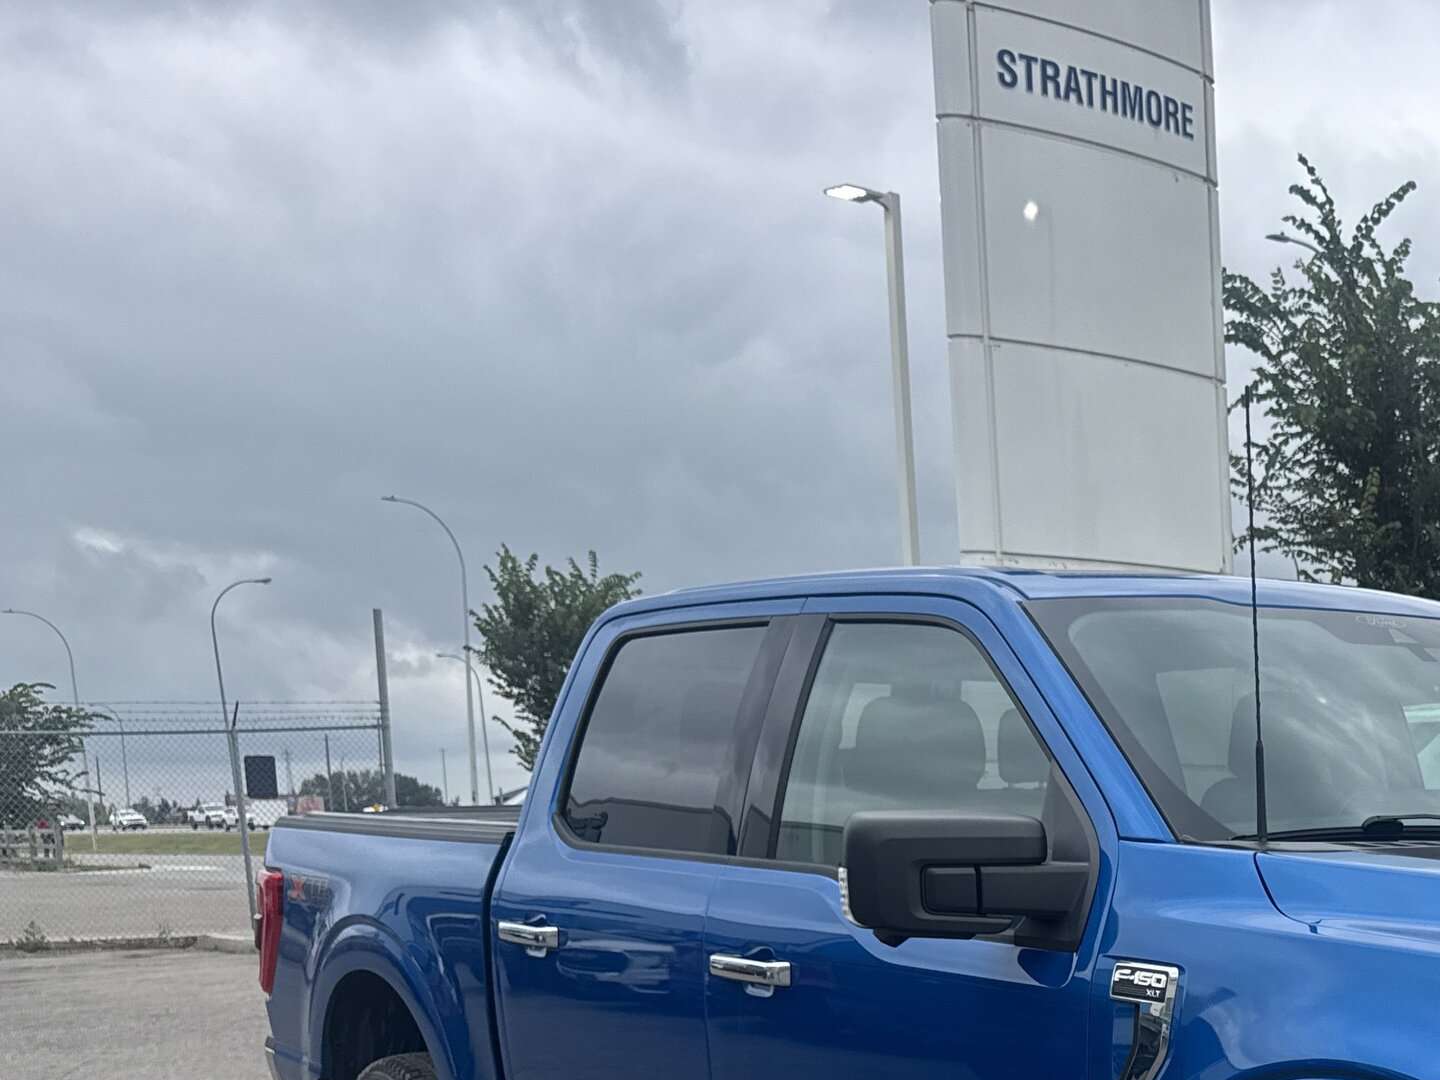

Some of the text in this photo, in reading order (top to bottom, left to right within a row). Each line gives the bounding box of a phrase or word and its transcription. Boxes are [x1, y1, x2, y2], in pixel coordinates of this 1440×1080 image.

[997, 49, 1194, 141] STRATHMORE
[1114, 969, 1167, 988] F-150
[1146, 988, 1161, 998] XLT
